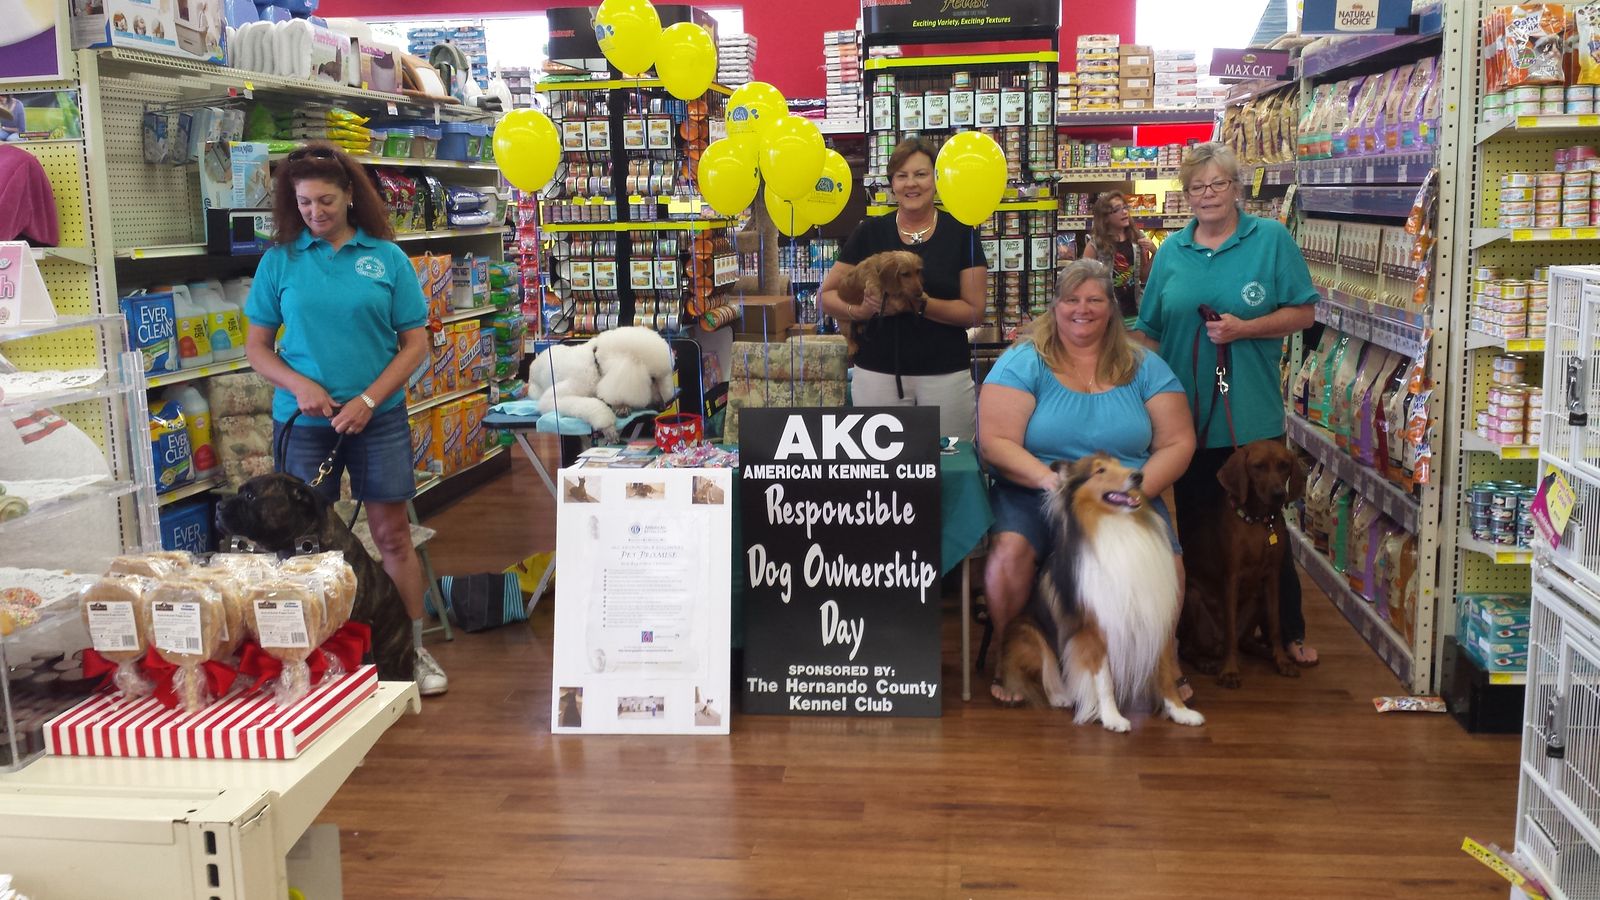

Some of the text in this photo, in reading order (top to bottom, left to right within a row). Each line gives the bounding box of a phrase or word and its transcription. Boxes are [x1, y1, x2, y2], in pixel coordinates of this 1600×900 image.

[912, 16, 1011, 28] Exciting Variety, Exciting Textures
[1338, 10, 1375, 18] NATURAL
[1341, 18, 1371, 26] CHOICE
[1513, 15, 1539, 27] Party
[1224, 63, 1272, 77] MAX CAT
[141, 305, 169, 325] EVER
[138, 323, 173, 343] CLEAN
[167, 433, 189, 450] EVER
[773, 413, 905, 461] AKC
[743, 463, 937, 480] AMERICAN KENNEL CLUB
[765, 483, 915, 539] Responsible
[173, 523, 201, 547] EVER
[747, 543, 792, 604] Dog
[803, 543, 937, 603] Ownership
[819, 600, 865, 661] Day
[788, 665, 896, 677] SPONSORED BY:
[746, 677, 938, 697] The Hernando County
[789, 695, 893, 712] Kennel Club
